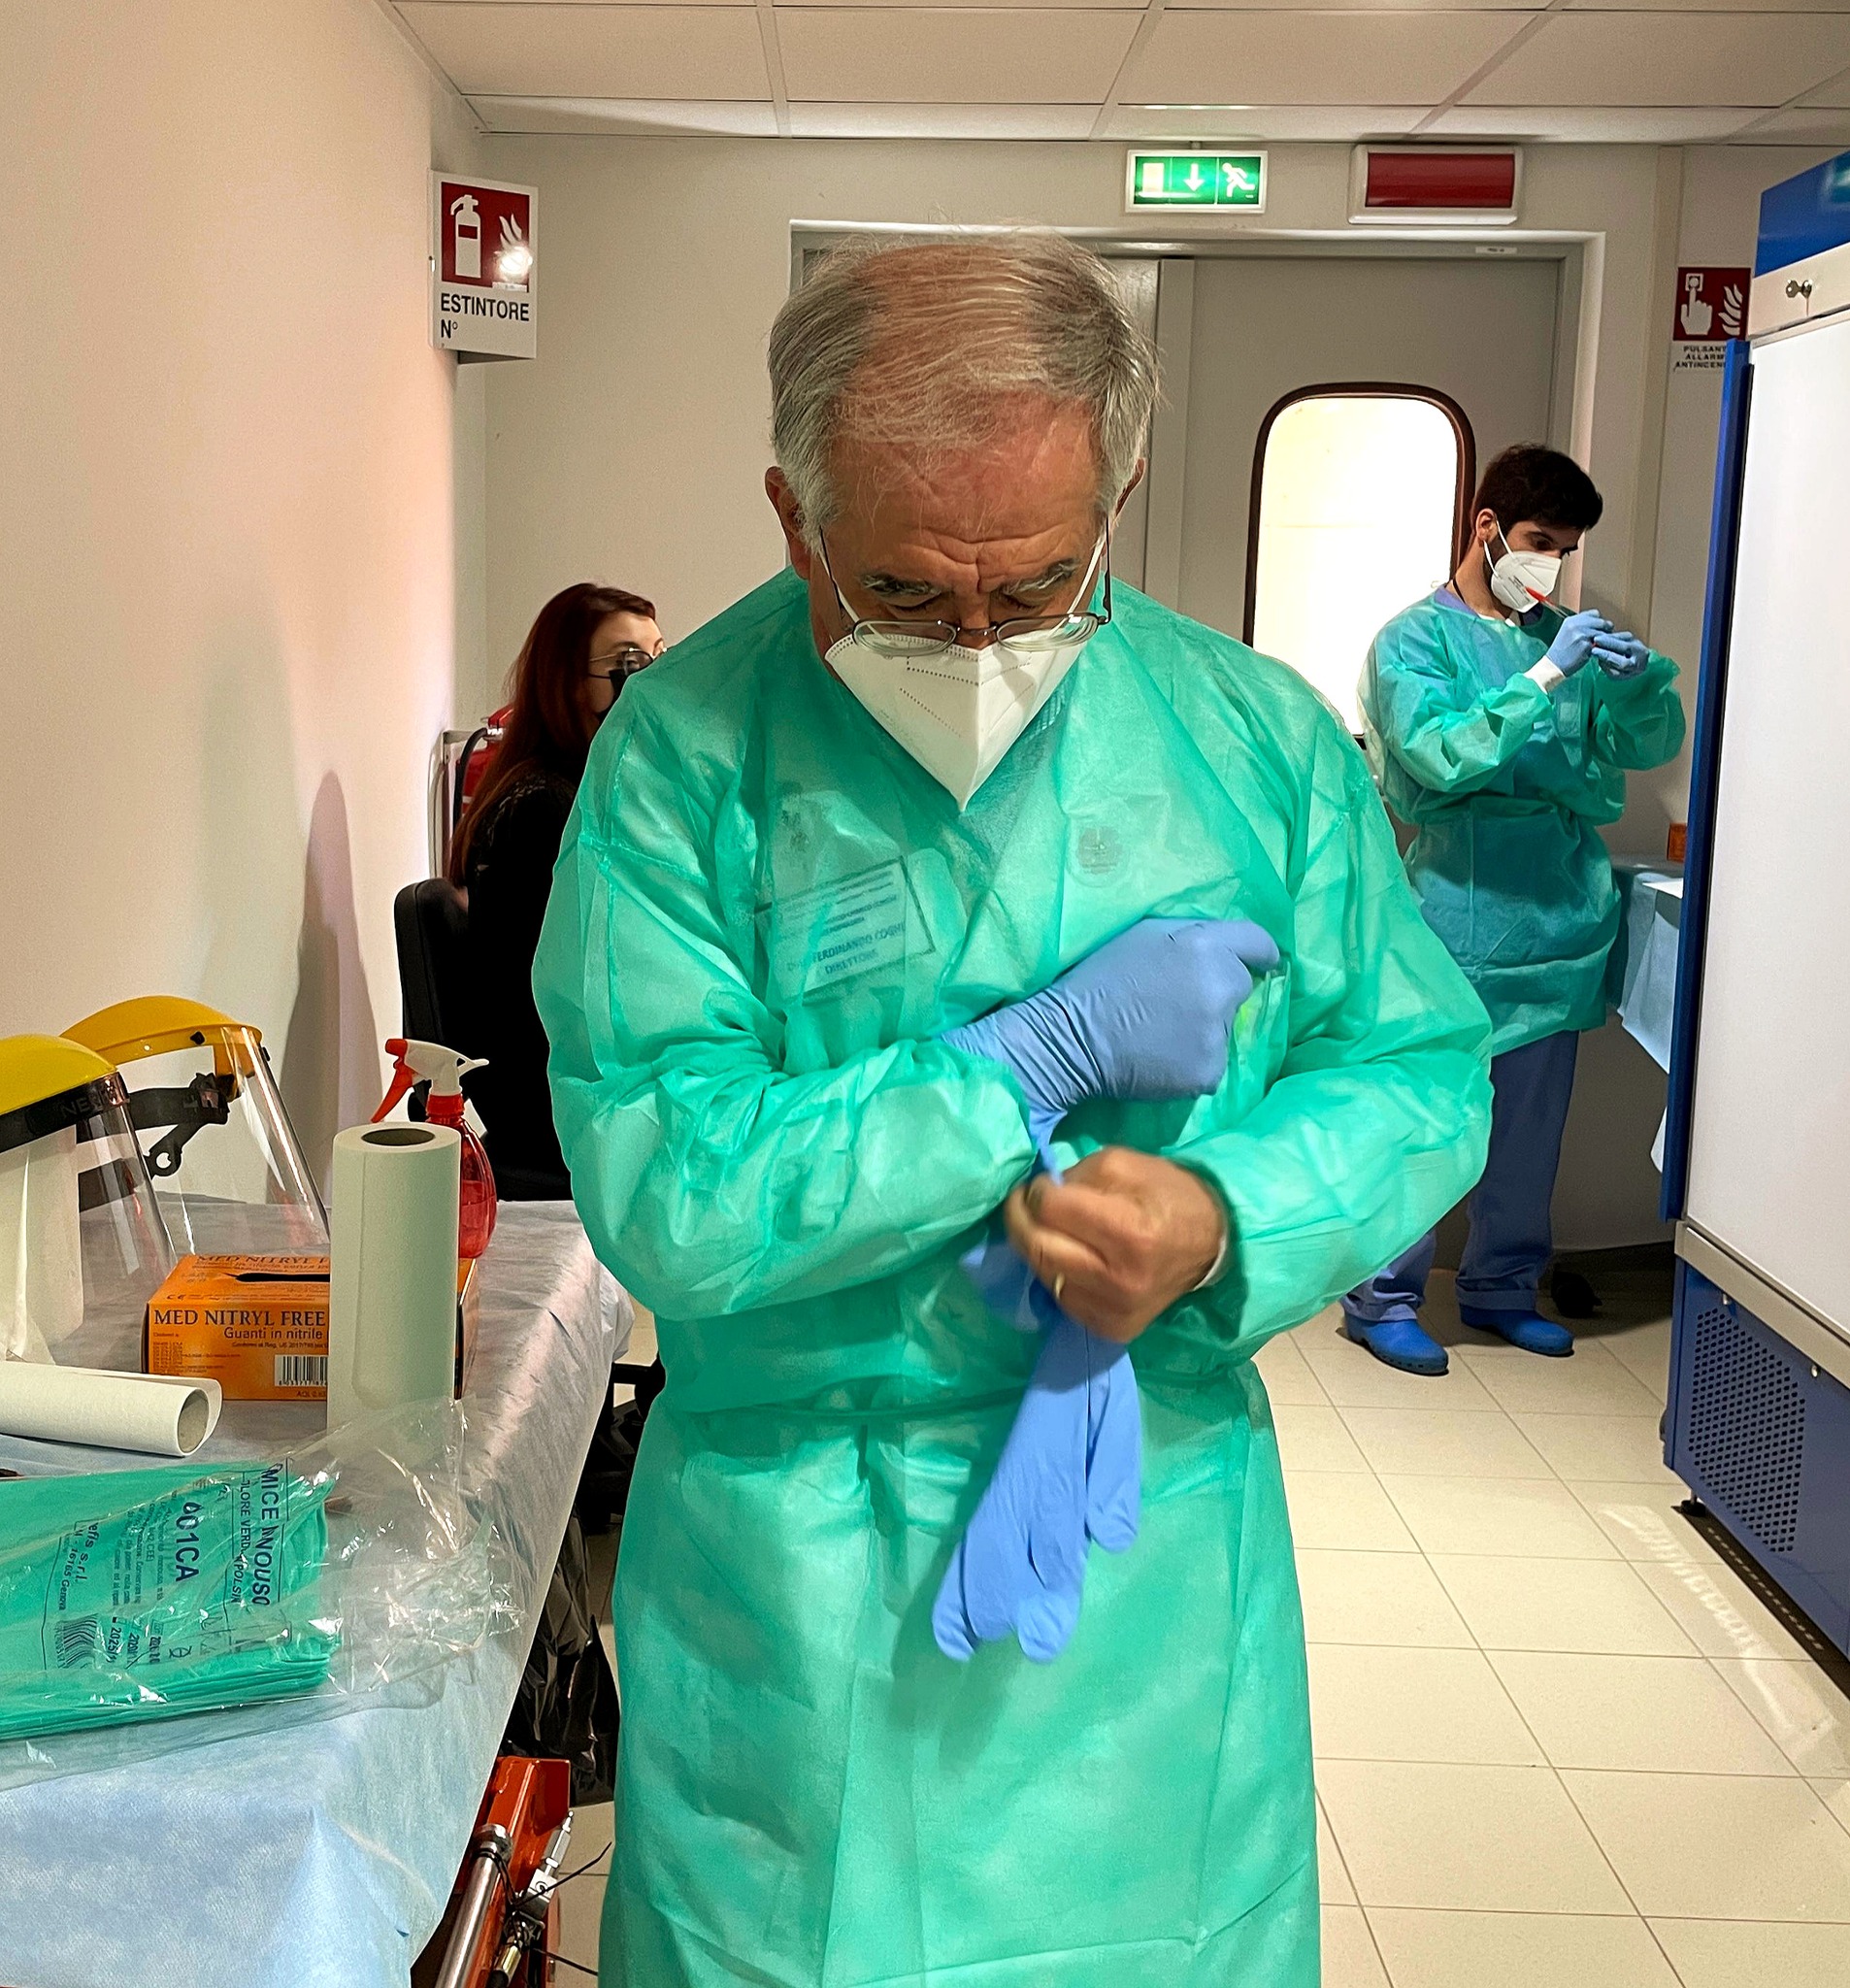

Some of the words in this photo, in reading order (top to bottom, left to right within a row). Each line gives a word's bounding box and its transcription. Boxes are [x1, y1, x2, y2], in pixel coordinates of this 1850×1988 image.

[441, 293, 530, 321] ESTINTORE
[153, 1309, 198, 1325] MED
[205, 1310, 275, 1326] NITRYL
[281, 1310, 326, 1327] FREE
[224, 1327, 267, 1340] Guanti
[270, 1327, 282, 1339] in
[286, 1327, 323, 1340] nitrile
